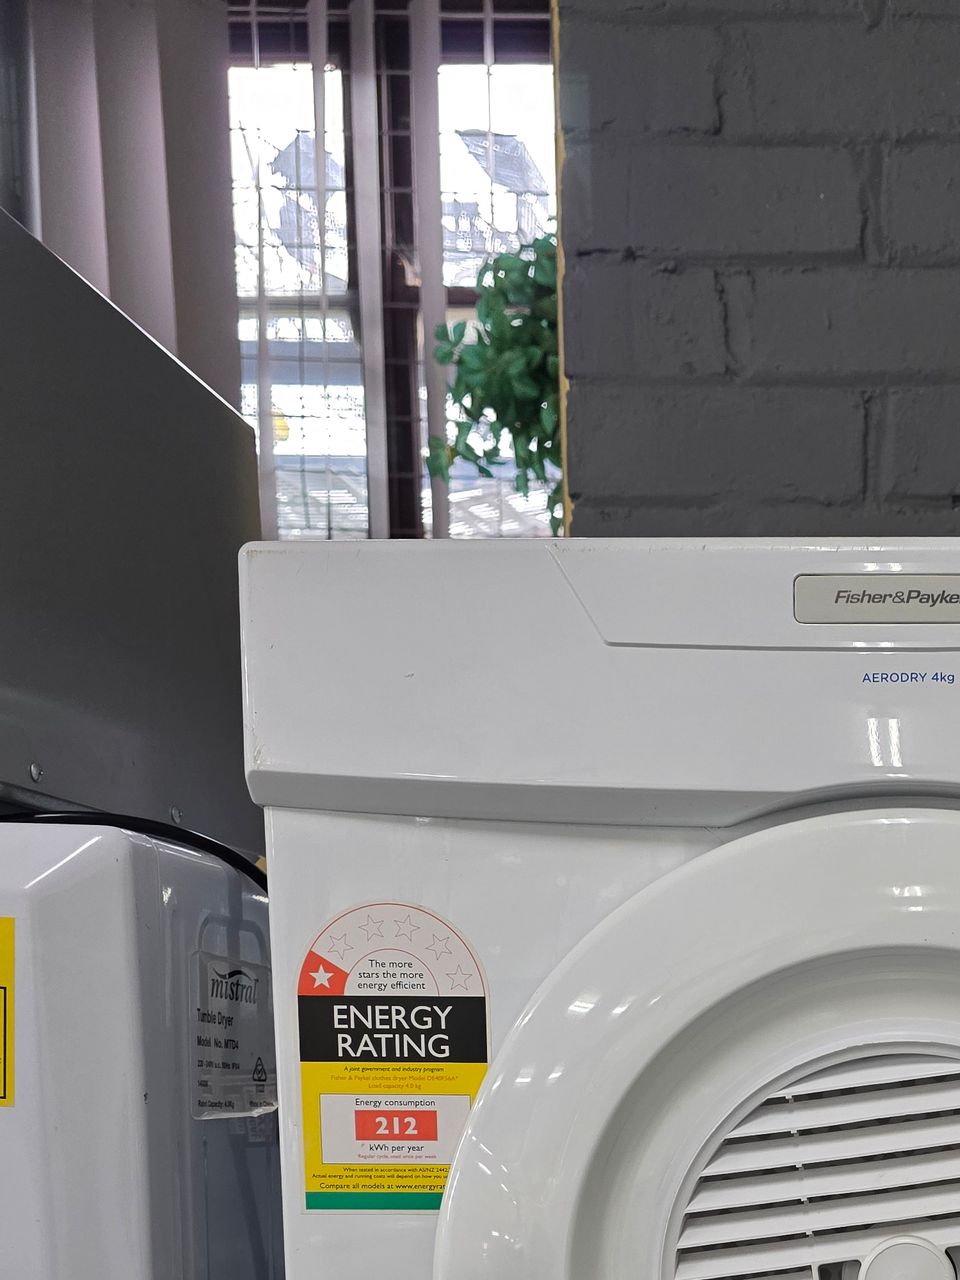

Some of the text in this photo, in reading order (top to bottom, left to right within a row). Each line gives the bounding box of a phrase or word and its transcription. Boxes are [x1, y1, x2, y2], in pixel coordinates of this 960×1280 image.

[862, 672, 955, 685] AERODRY 4kg
[368, 959, 386, 968] The
[382, 970, 397, 979] the
[357, 980, 426, 992] energy efficient
[333, 1004, 453, 1030] ENERGY
[337, 1033, 451, 1059] RATING
[355, 1098, 436, 1108] Energy consumption
[375, 1117, 419, 1135] 212
[369, 1144, 424, 1154] kWh per year
[320, 1183, 350, 1191] Compare
